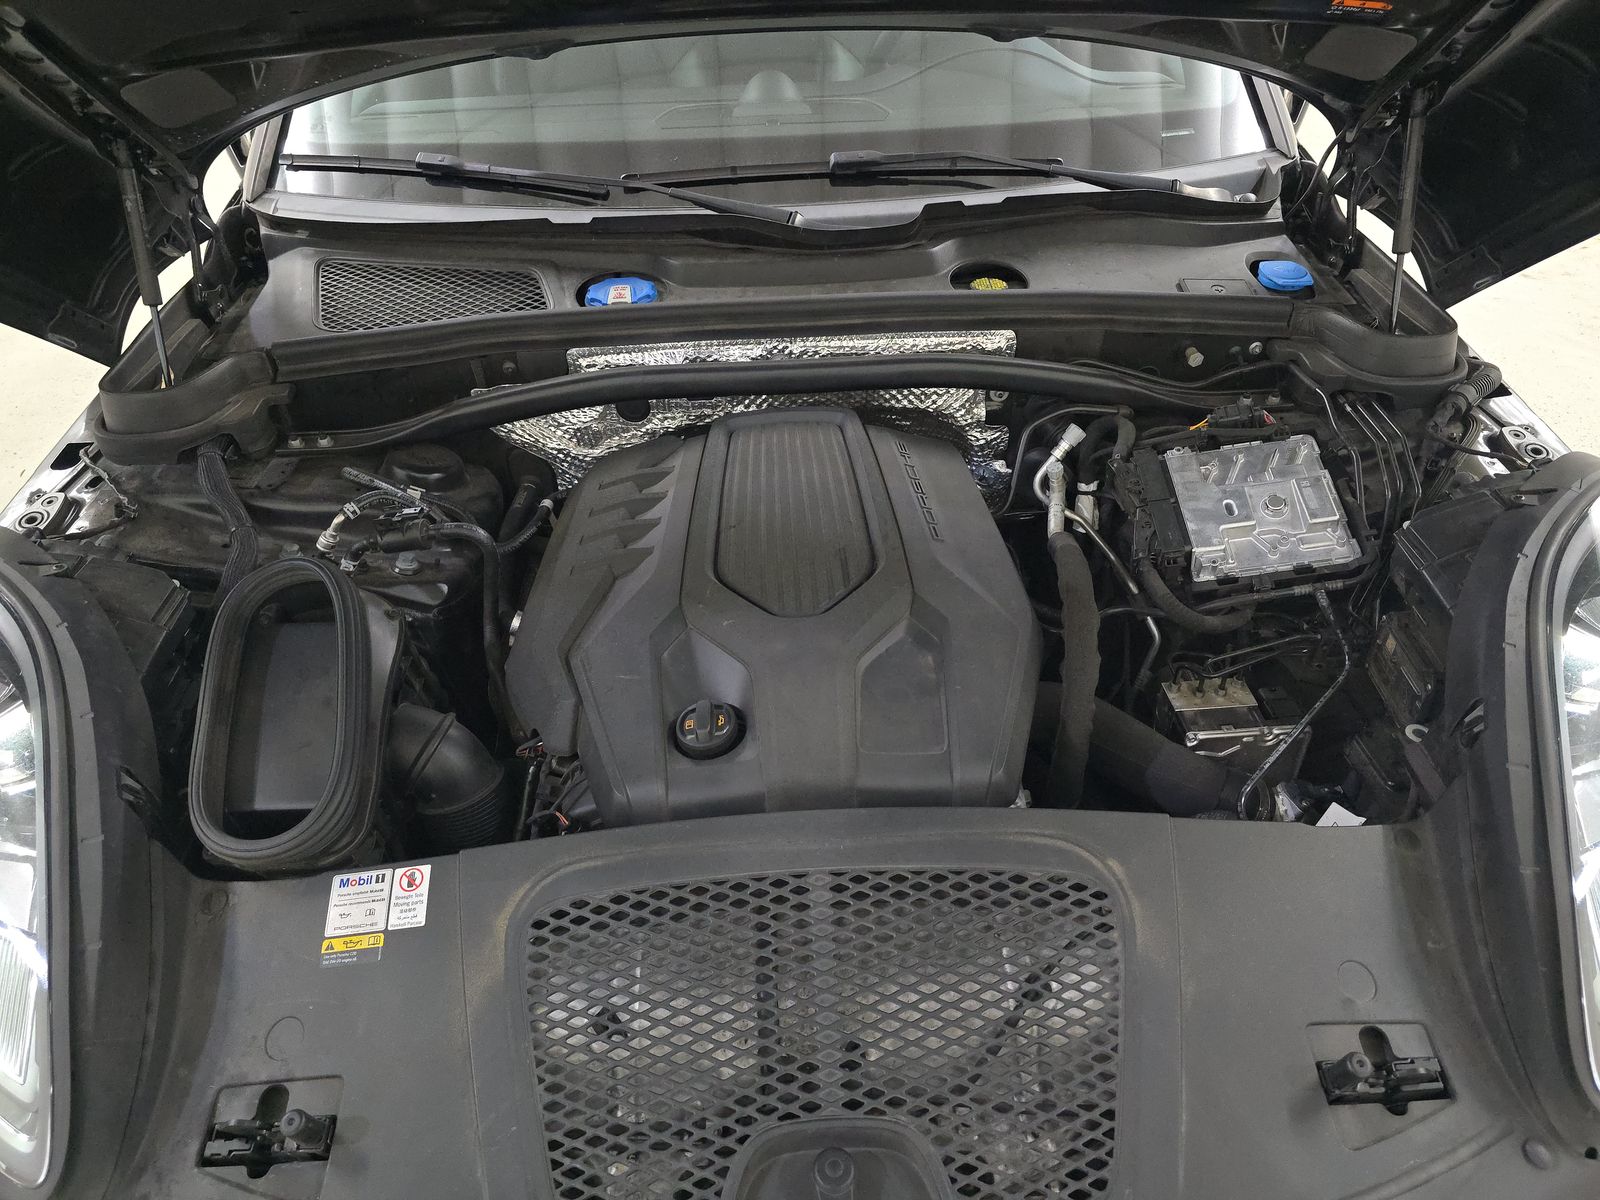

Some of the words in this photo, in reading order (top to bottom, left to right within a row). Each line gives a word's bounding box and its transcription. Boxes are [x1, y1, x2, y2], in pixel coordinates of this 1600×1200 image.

[895, 440, 944, 541] PORSCHE
[339, 875, 373, 888] Mobil
[411, 899, 424, 907] parts
[333, 921, 378, 931] PORSCHE
